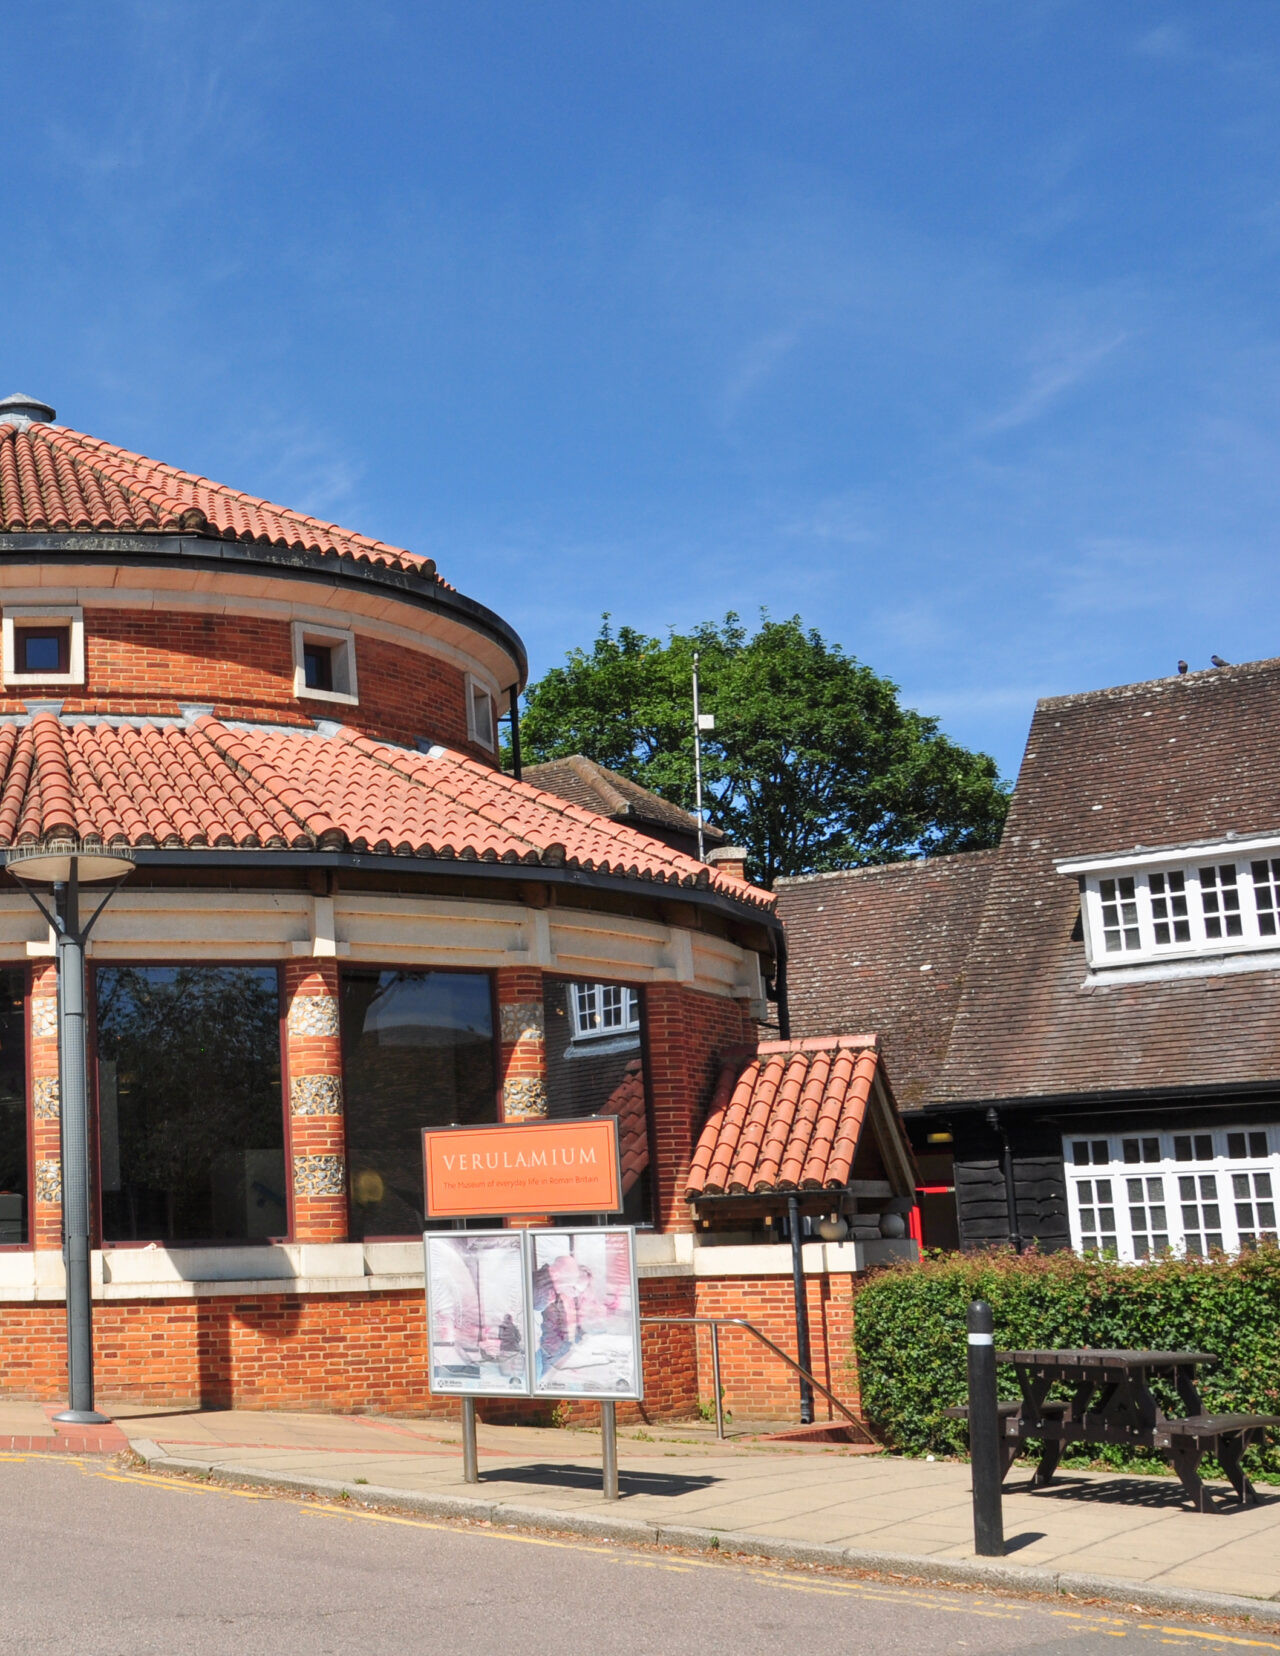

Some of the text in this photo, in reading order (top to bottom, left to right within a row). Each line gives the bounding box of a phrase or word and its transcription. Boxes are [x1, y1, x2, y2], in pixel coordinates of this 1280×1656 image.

[442, 1147, 597, 1171] VERULAMIUM
[457, 1181, 486, 1189] Museum
[487, 1180, 495, 1188] of
[495, 1179, 527, 1188] everyday
[528, 1177, 539, 1186] life
[549, 1177, 574, 1185] Roman
[575, 1175, 599, 1184] Britain
